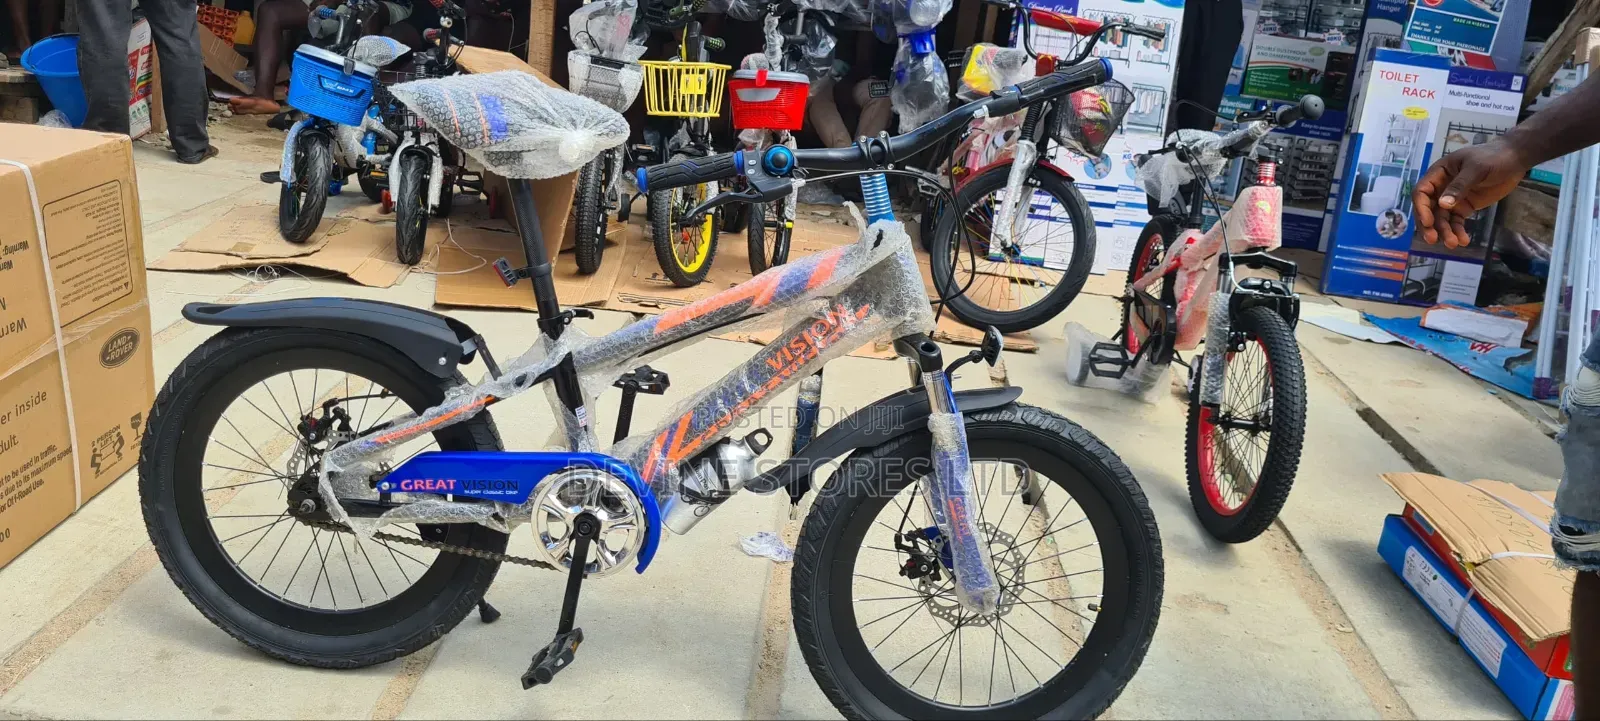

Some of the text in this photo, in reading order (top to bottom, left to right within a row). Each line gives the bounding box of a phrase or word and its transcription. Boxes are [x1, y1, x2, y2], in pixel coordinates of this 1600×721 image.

[1379, 70, 1420, 84] TOILET
[1402, 87, 1436, 100] RACK
[108, 336, 127, 353] LAND
[766, 303, 846, 370] VISION
[110, 342, 133, 361] ROVER
[15, 391, 47, 417] inside
[97, 424, 121, 443] PERSON
[20, 458, 33, 473] used
[5, 485, 15, 496] due
[31, 457, 56, 478] maximum
[33, 478, 44, 491] Use.
[400, 479, 519, 491] GREAT VISION
